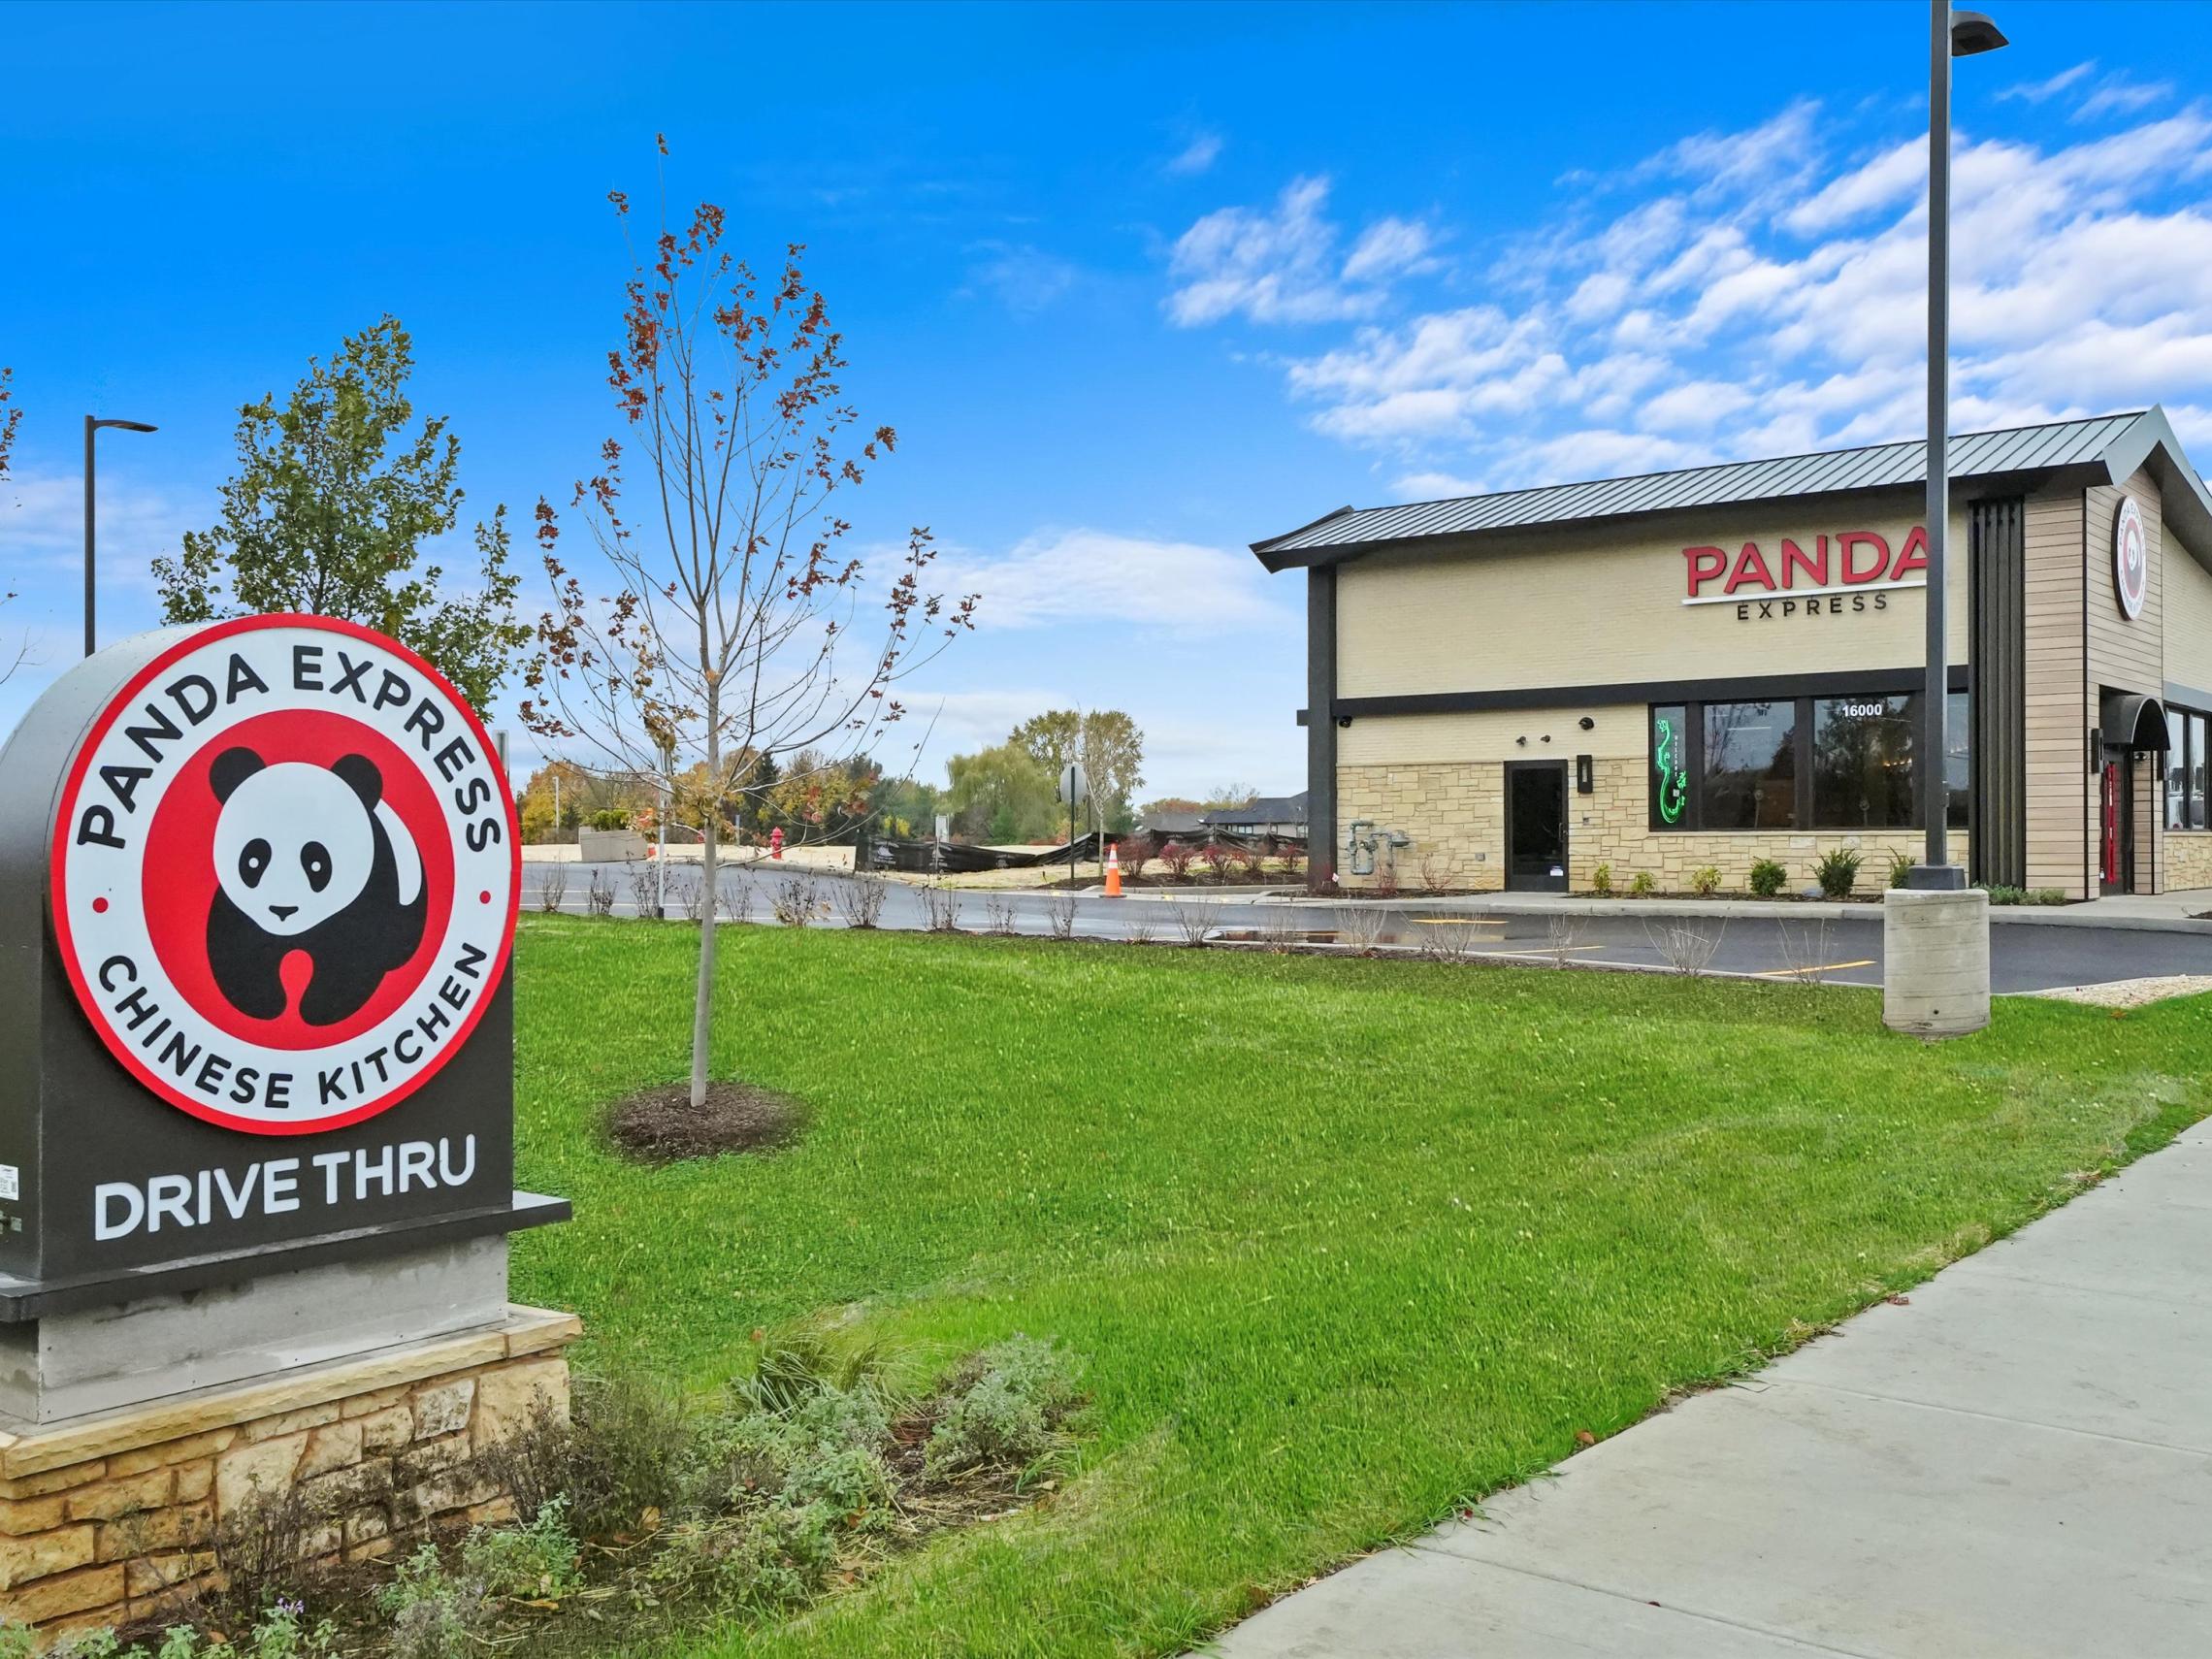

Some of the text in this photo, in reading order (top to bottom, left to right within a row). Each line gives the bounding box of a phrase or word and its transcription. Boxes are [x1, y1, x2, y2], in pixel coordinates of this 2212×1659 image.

[1682, 526, 1928, 598] PANDA
[1737, 594, 1887, 621] EXPRESS
[78, 645, 501, 853] PANDA EXPRESS
[1842, 703, 1882, 717] 16000
[99, 942, 487, 1109] CHINESE KITCHEN
[95, 1163, 300, 1241] DRIVE
[312, 1133, 475, 1205] THRU
